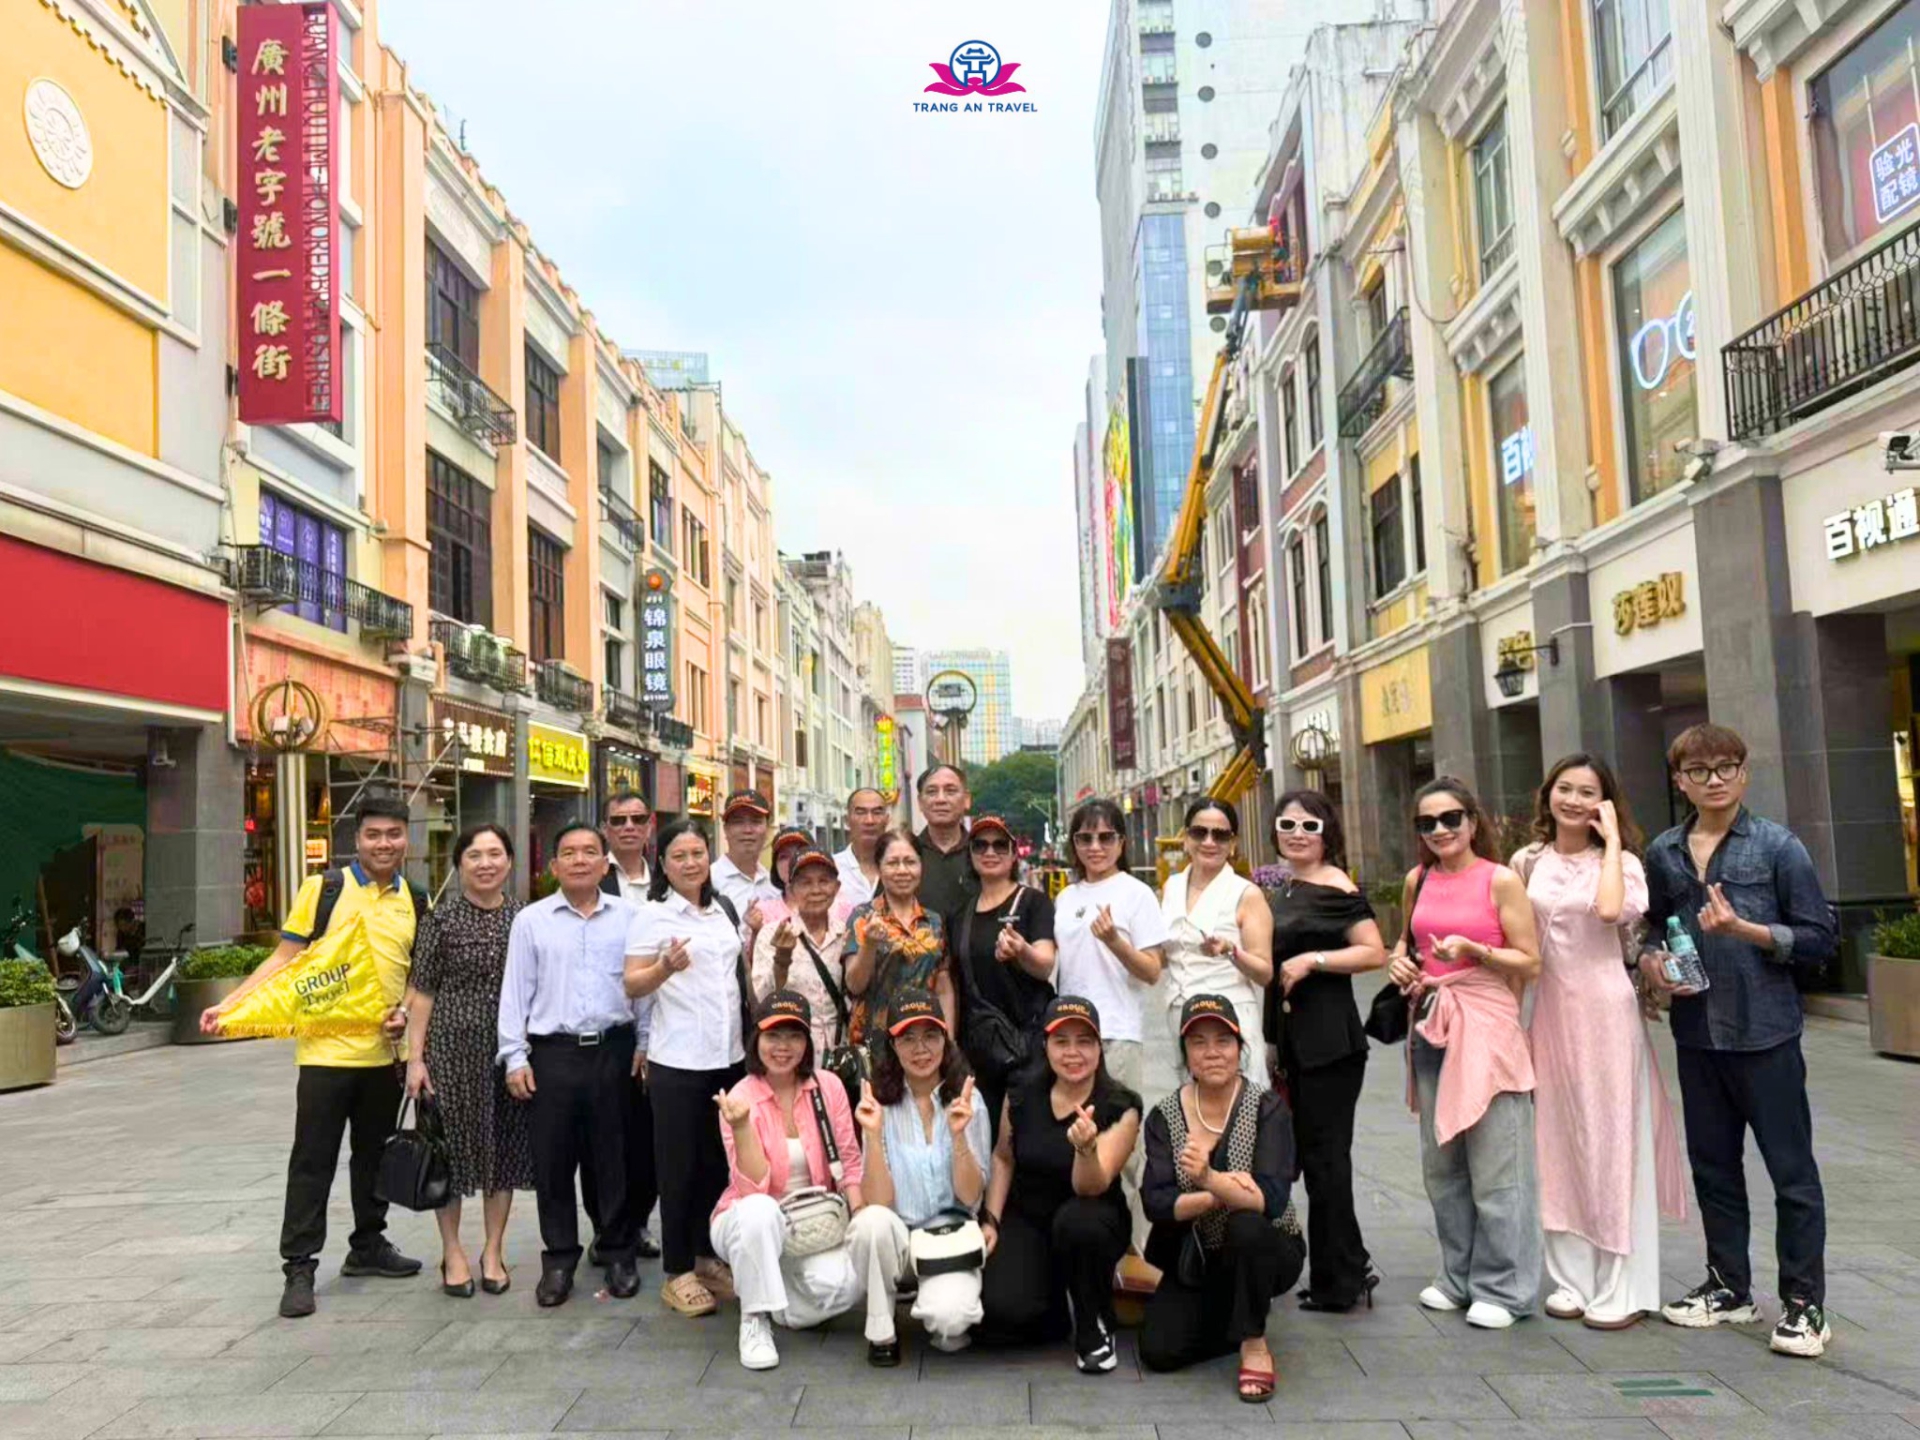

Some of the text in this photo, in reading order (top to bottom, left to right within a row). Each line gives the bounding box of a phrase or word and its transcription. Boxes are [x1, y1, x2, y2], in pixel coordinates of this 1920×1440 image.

[1875, 137, 1914, 181] 验光
[251, 39, 291, 381] 廣州老字號一條街
[1881, 166, 1918, 211] 配镜
[1823, 488, 1920, 560] 百视通
[644, 608, 668, 691] 锦泉眼镜
[295, 963, 351, 995] GROUP
